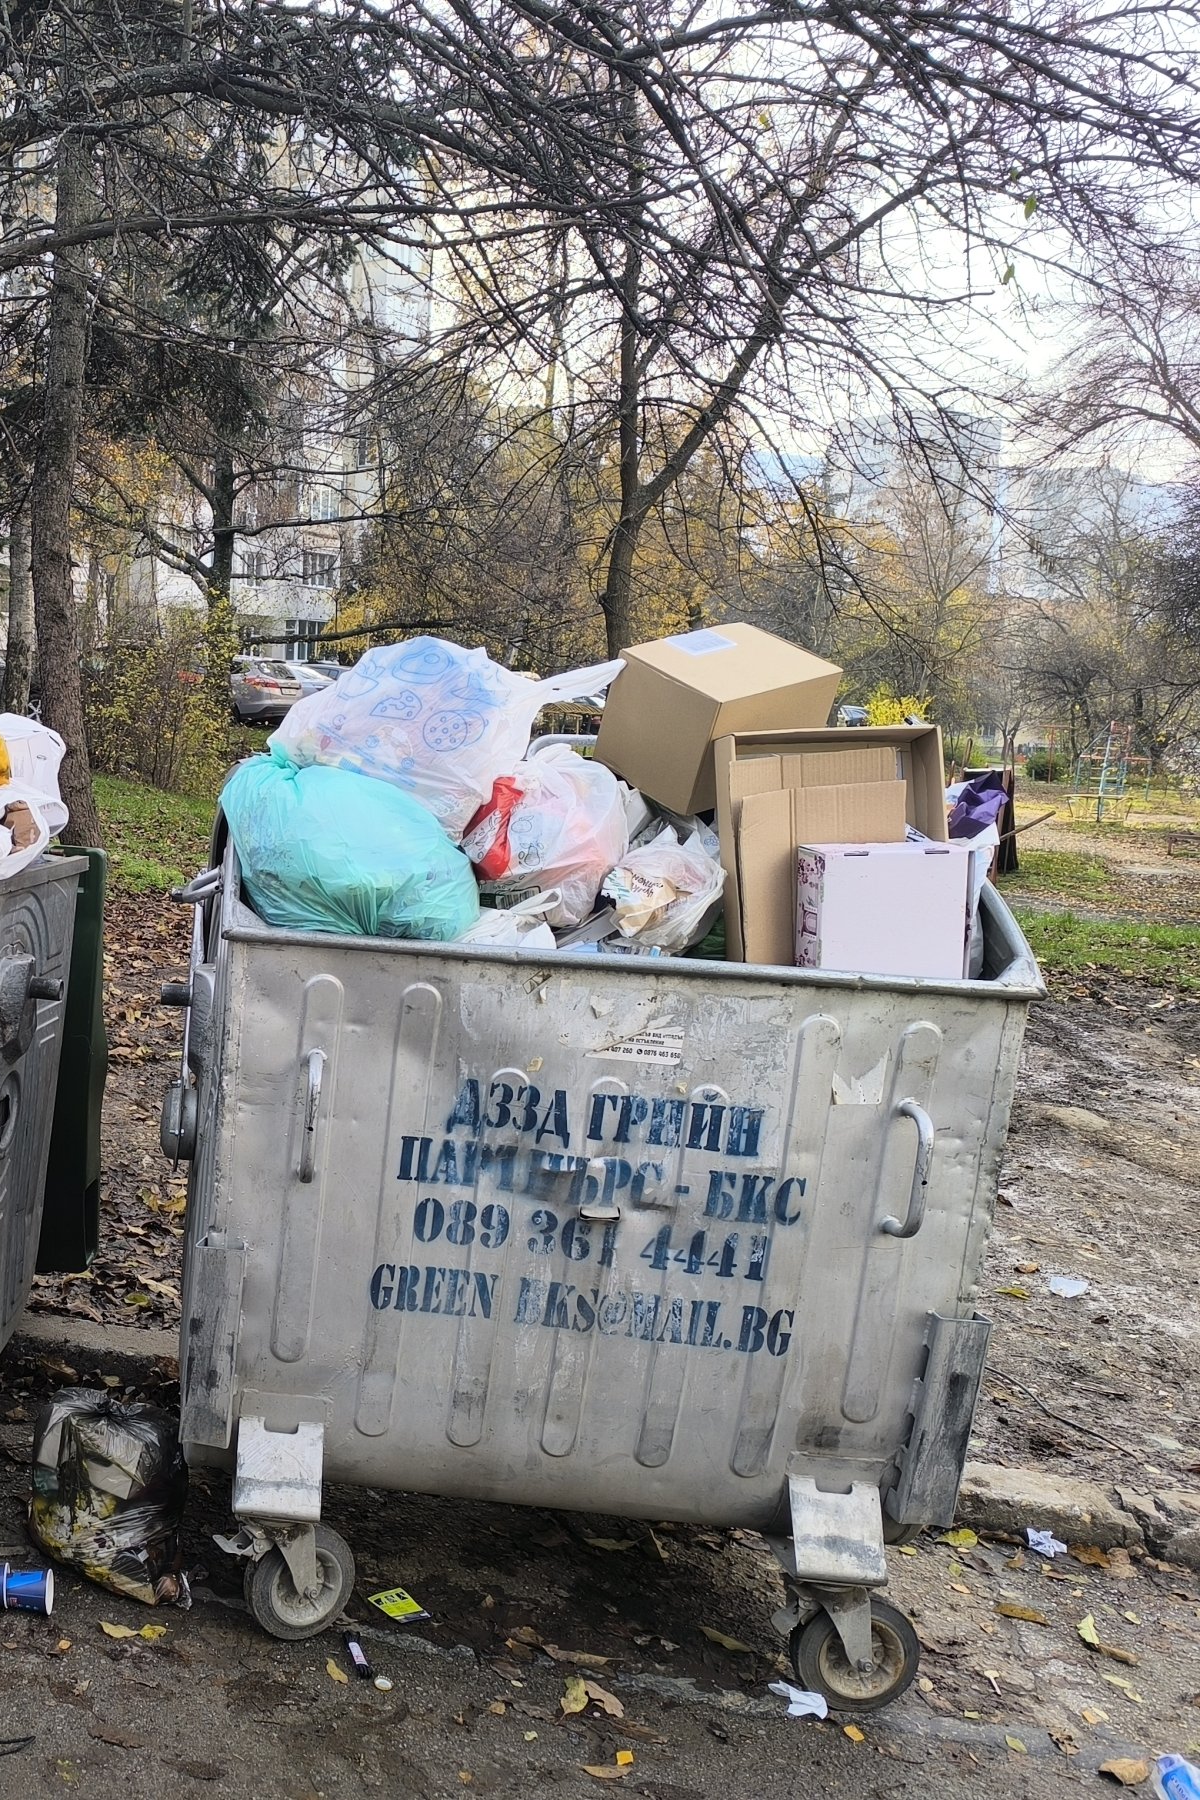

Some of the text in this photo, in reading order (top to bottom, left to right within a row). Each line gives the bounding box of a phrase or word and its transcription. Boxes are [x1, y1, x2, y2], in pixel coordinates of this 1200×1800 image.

[703, 1169, 807, 1226] БКС
[414, 1197, 768, 1281] 089 361 4441
[370, 1263, 500, 1319] GREEN
